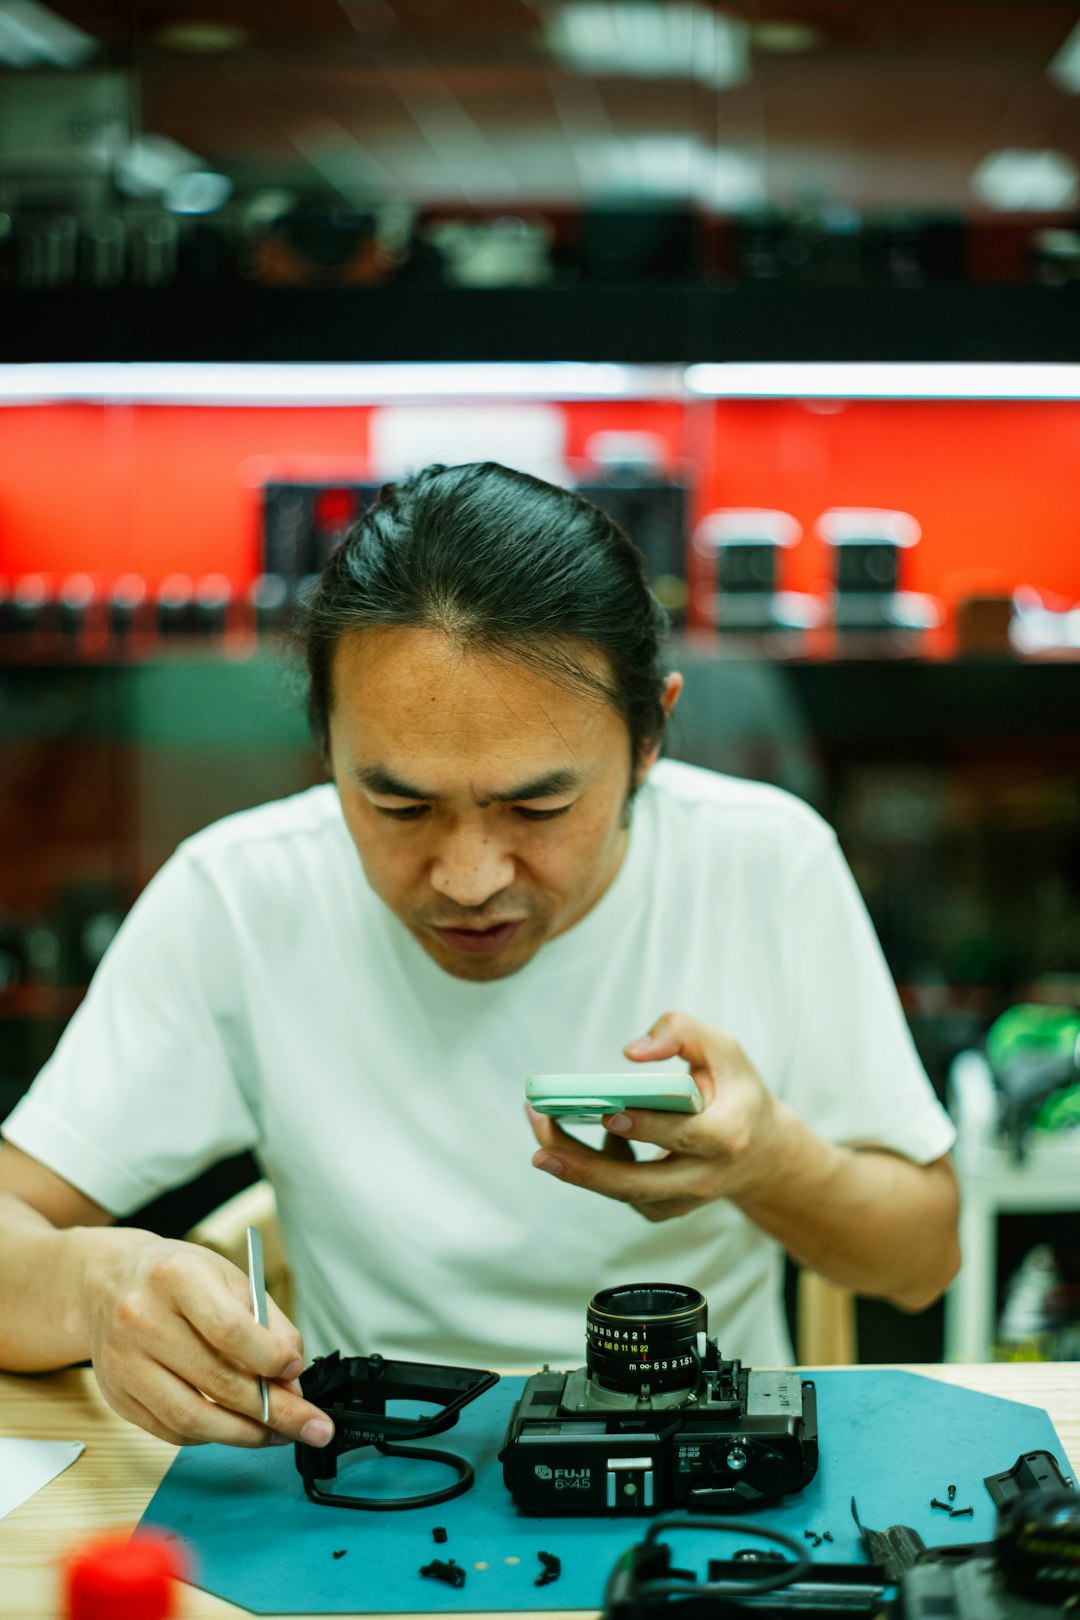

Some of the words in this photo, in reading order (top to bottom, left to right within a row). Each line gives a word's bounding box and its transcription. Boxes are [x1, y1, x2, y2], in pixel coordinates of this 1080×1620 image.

[613, 1330, 620, 1338] 8
[622, 1331, 629, 1339] 4
[631, 1332, 638, 1340] 2
[642, 1332, 647, 1340] 1
[613, 1343, 619, 1351] 8
[621, 1344, 629, 1352] 11
[630, 1344, 638, 1352] 16
[639, 1345, 649, 1353] 22
[653, 1362, 660, 1370] 5
[661, 1361, 668, 1369] 3
[671, 1360, 678, 1368] 2
[554, 1468, 591, 1479] FUJI
